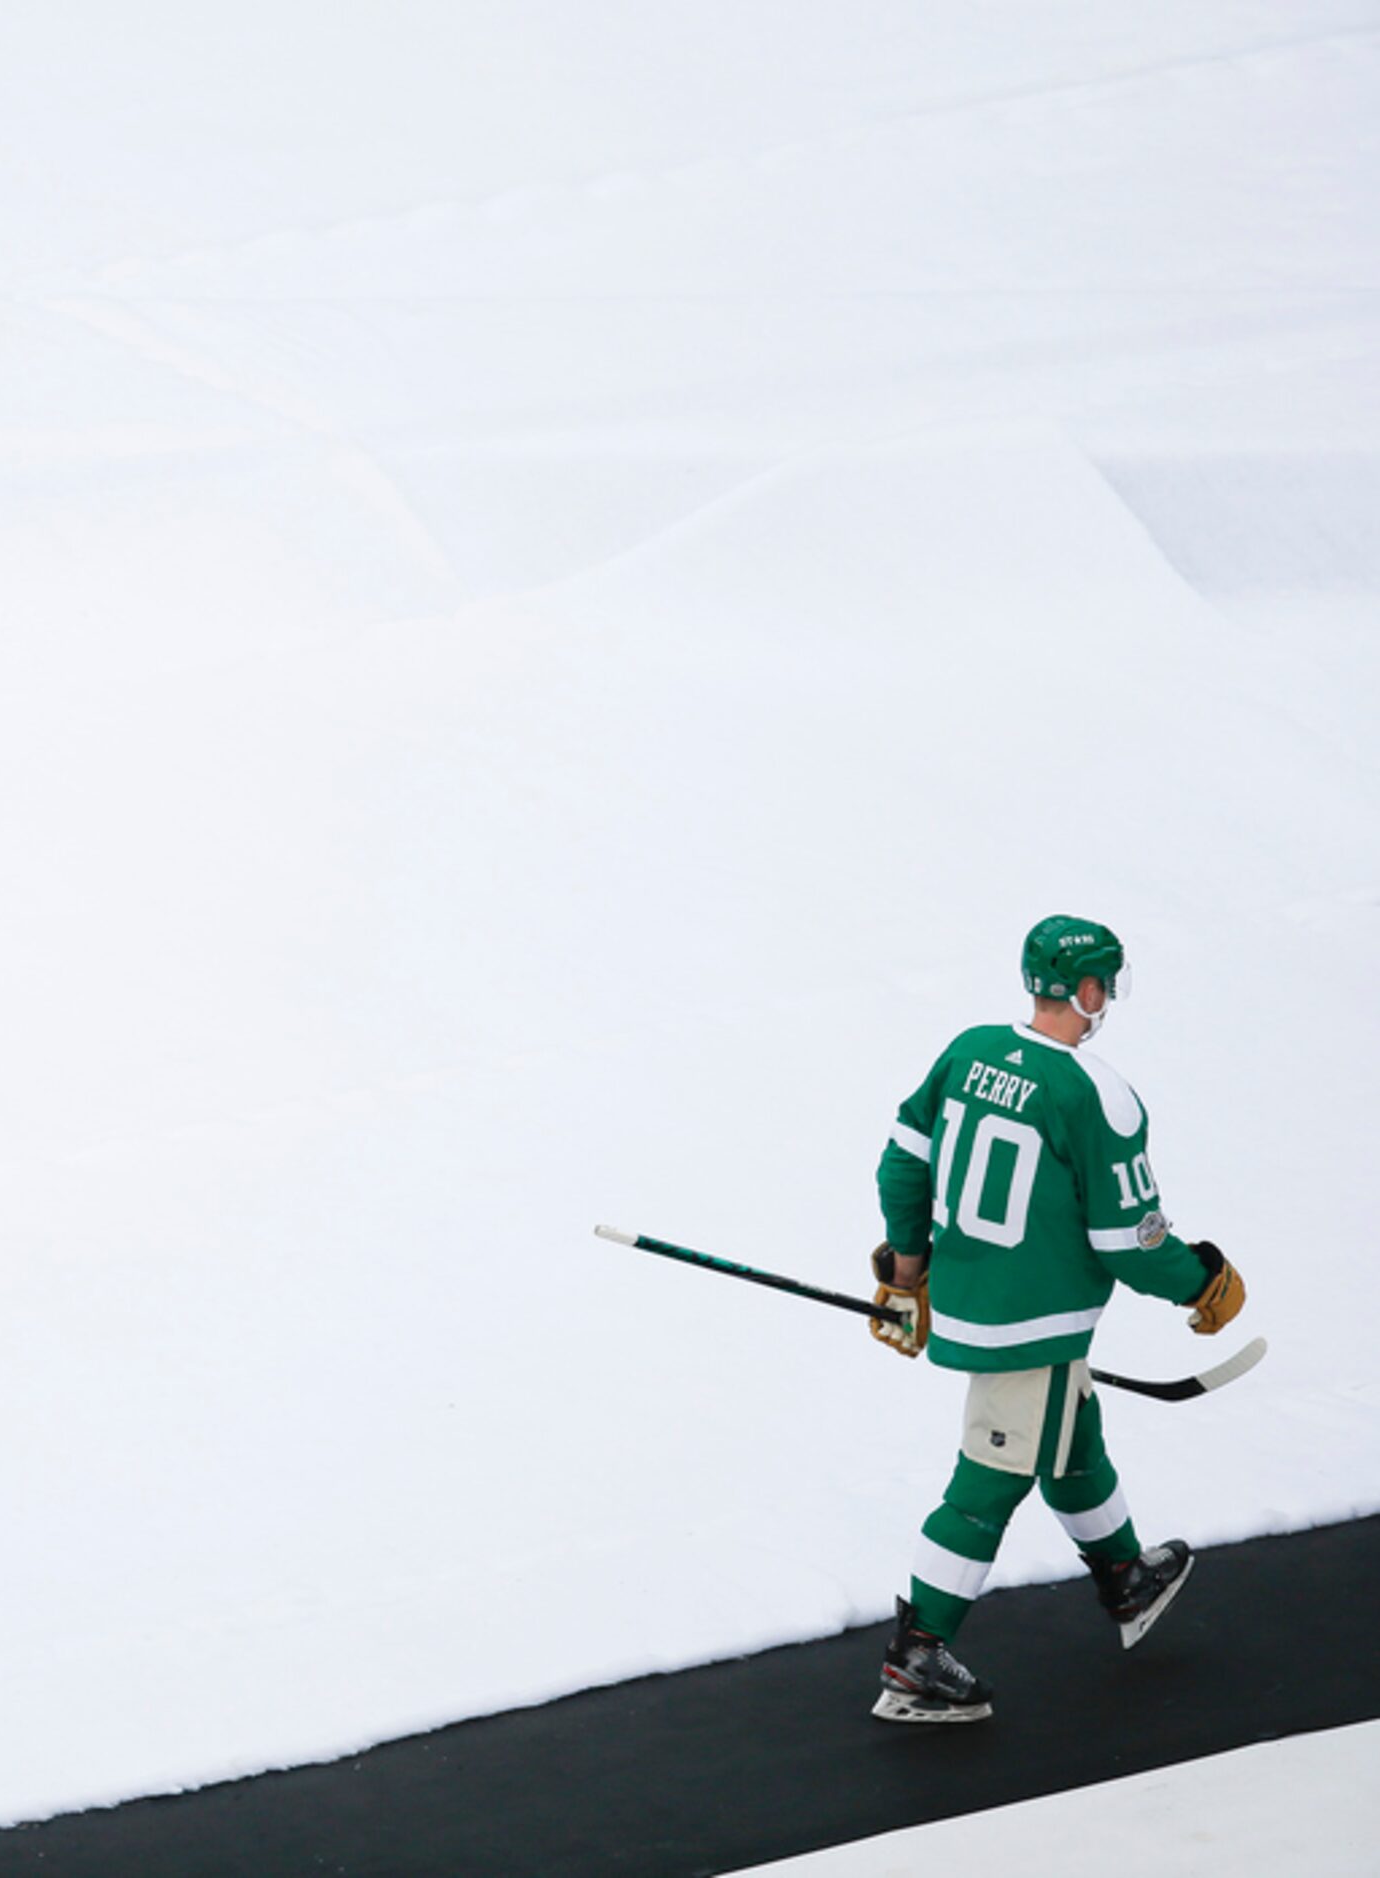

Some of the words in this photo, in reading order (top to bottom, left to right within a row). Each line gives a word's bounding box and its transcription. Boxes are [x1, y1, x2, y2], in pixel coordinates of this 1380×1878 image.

[962, 1060, 1038, 1113] PERRY
[932, 1097, 1044, 1249] 10
[1111, 1152, 1158, 1210] 10
